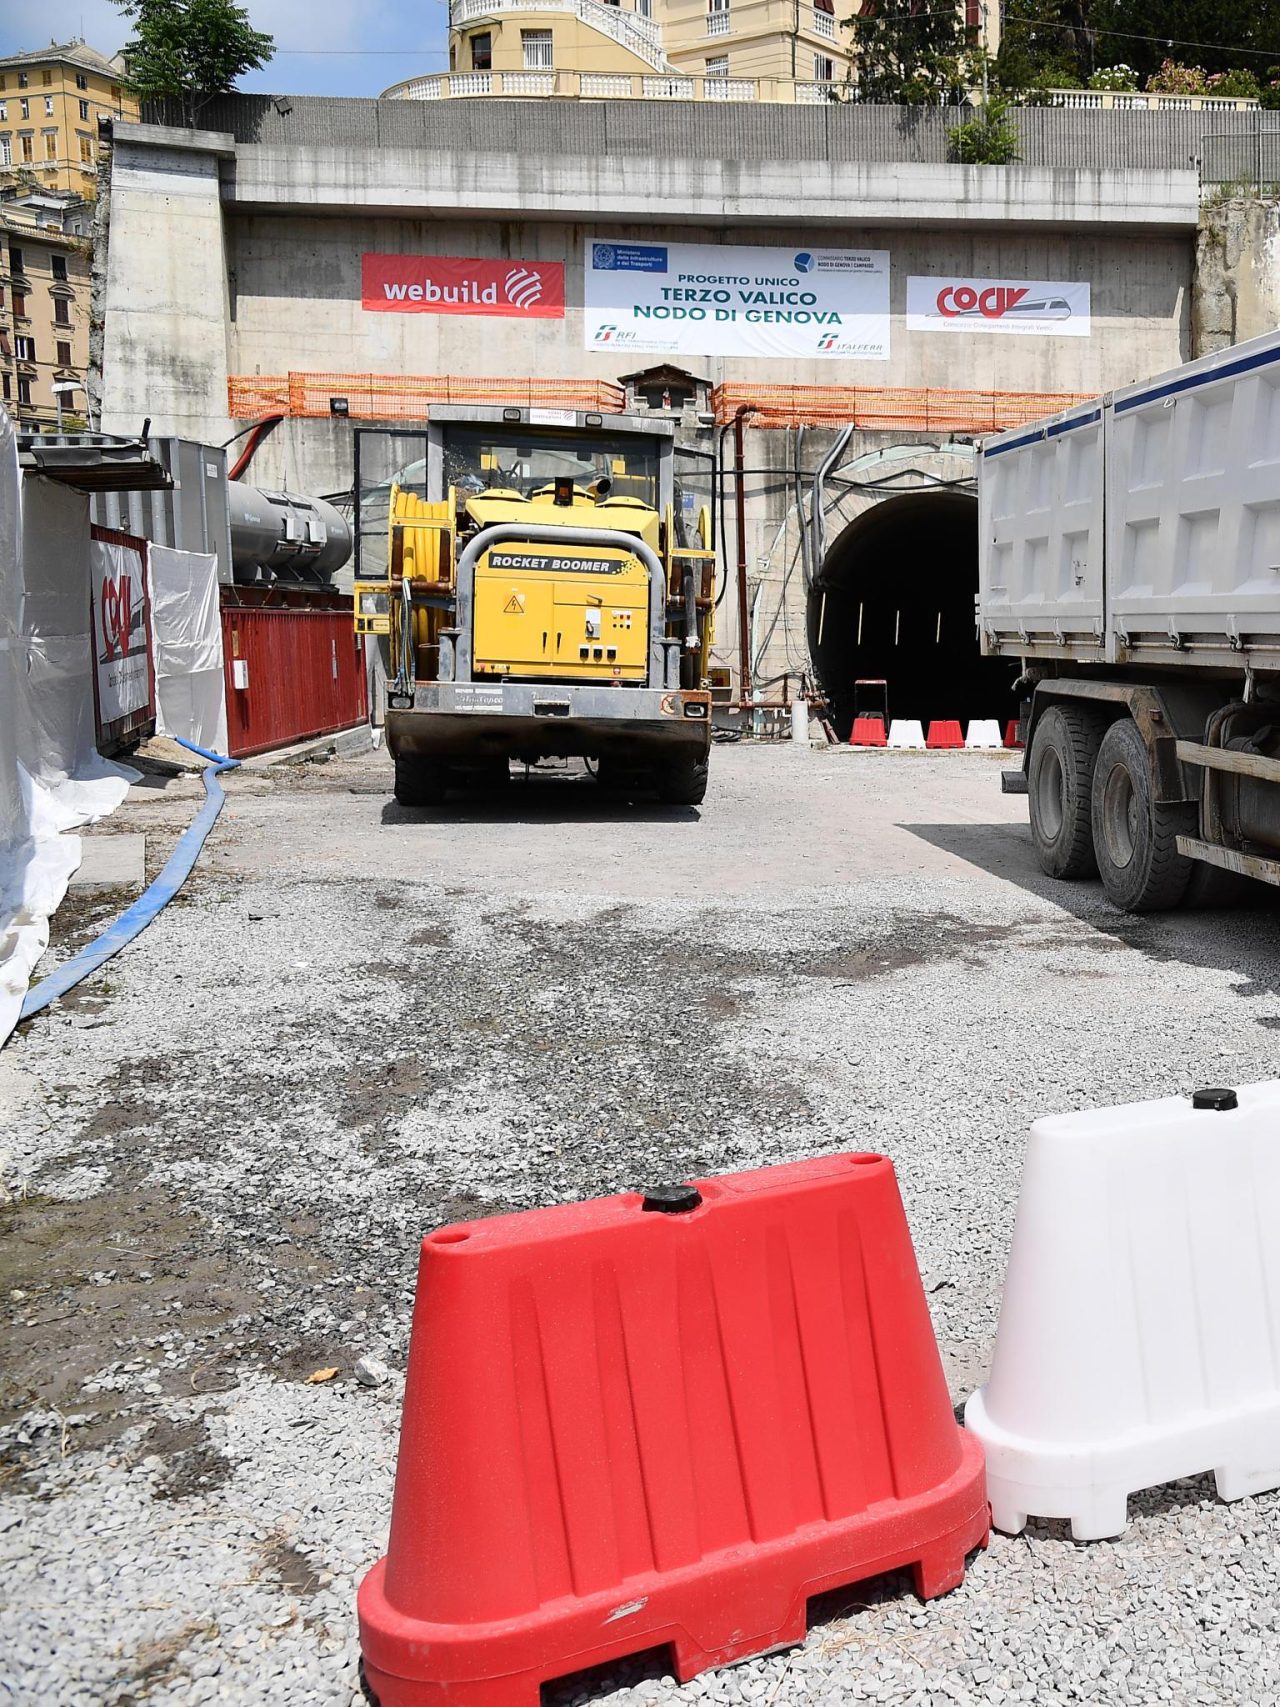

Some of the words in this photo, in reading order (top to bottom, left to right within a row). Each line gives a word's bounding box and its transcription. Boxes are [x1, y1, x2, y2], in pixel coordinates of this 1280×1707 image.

[678, 274, 750, 286] PROGETTO
[754, 277, 800, 287] UNICO
[383, 279, 498, 305] webuild
[660, 287, 731, 304] TERZO
[738, 290, 818, 306] VALICO
[633, 305, 711, 321] NODO
[715, 308, 737, 322] DI
[745, 309, 843, 325] GENOVA
[616, 331, 637, 339] RFI
[492, 556, 548, 569] ROCKET
[551, 559, 610, 572] BOOMER
